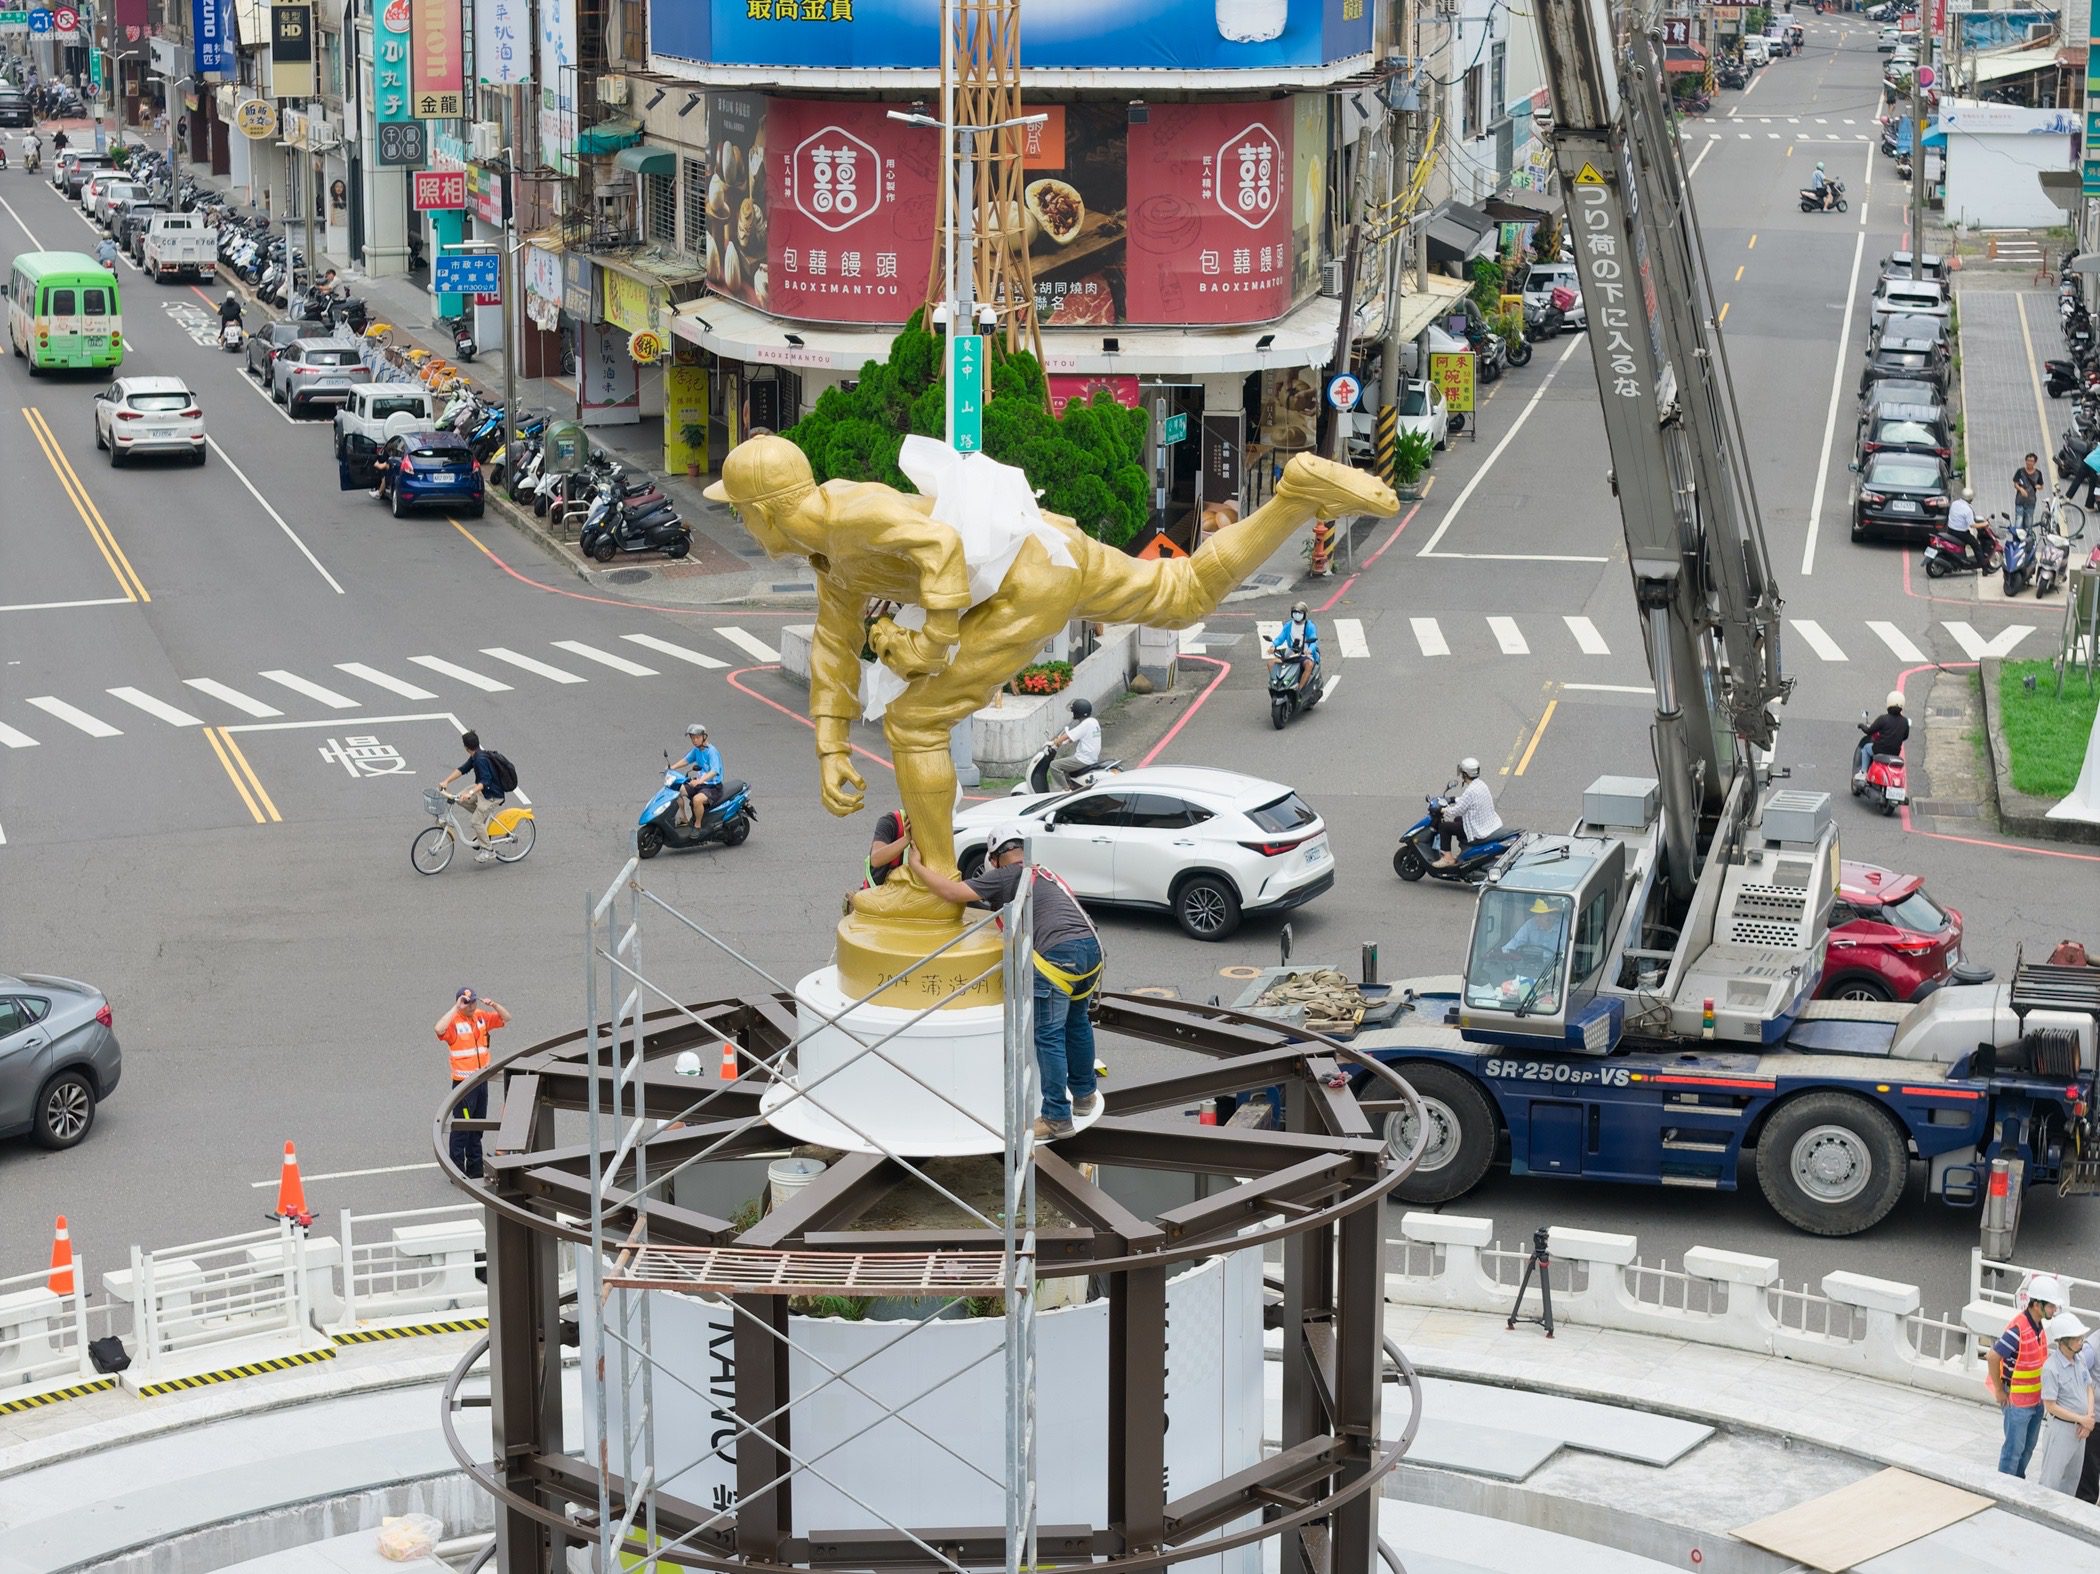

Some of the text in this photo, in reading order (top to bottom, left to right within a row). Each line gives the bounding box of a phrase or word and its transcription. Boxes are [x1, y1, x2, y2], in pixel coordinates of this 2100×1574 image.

[281, 24, 301, 36] HD
[421, 96, 457, 113] 金龍
[1202, 156, 1212, 200] 匠人精神
[1623, 138, 1638, 215] KATO
[419, 177, 463, 205] 照相
[451, 260, 495, 269] 市政中心
[451, 273, 495, 282] 停車場
[784, 280, 898, 295] BAOXIMANTOU
[1578, 186, 1641, 398] つり荷の下に入るな
[963, 339, 973, 352] 東
[758, 350, 830, 363] BAOXIMANTOU
[960, 363, 974, 449] 中山路
[318, 735, 416, 777] 慢
